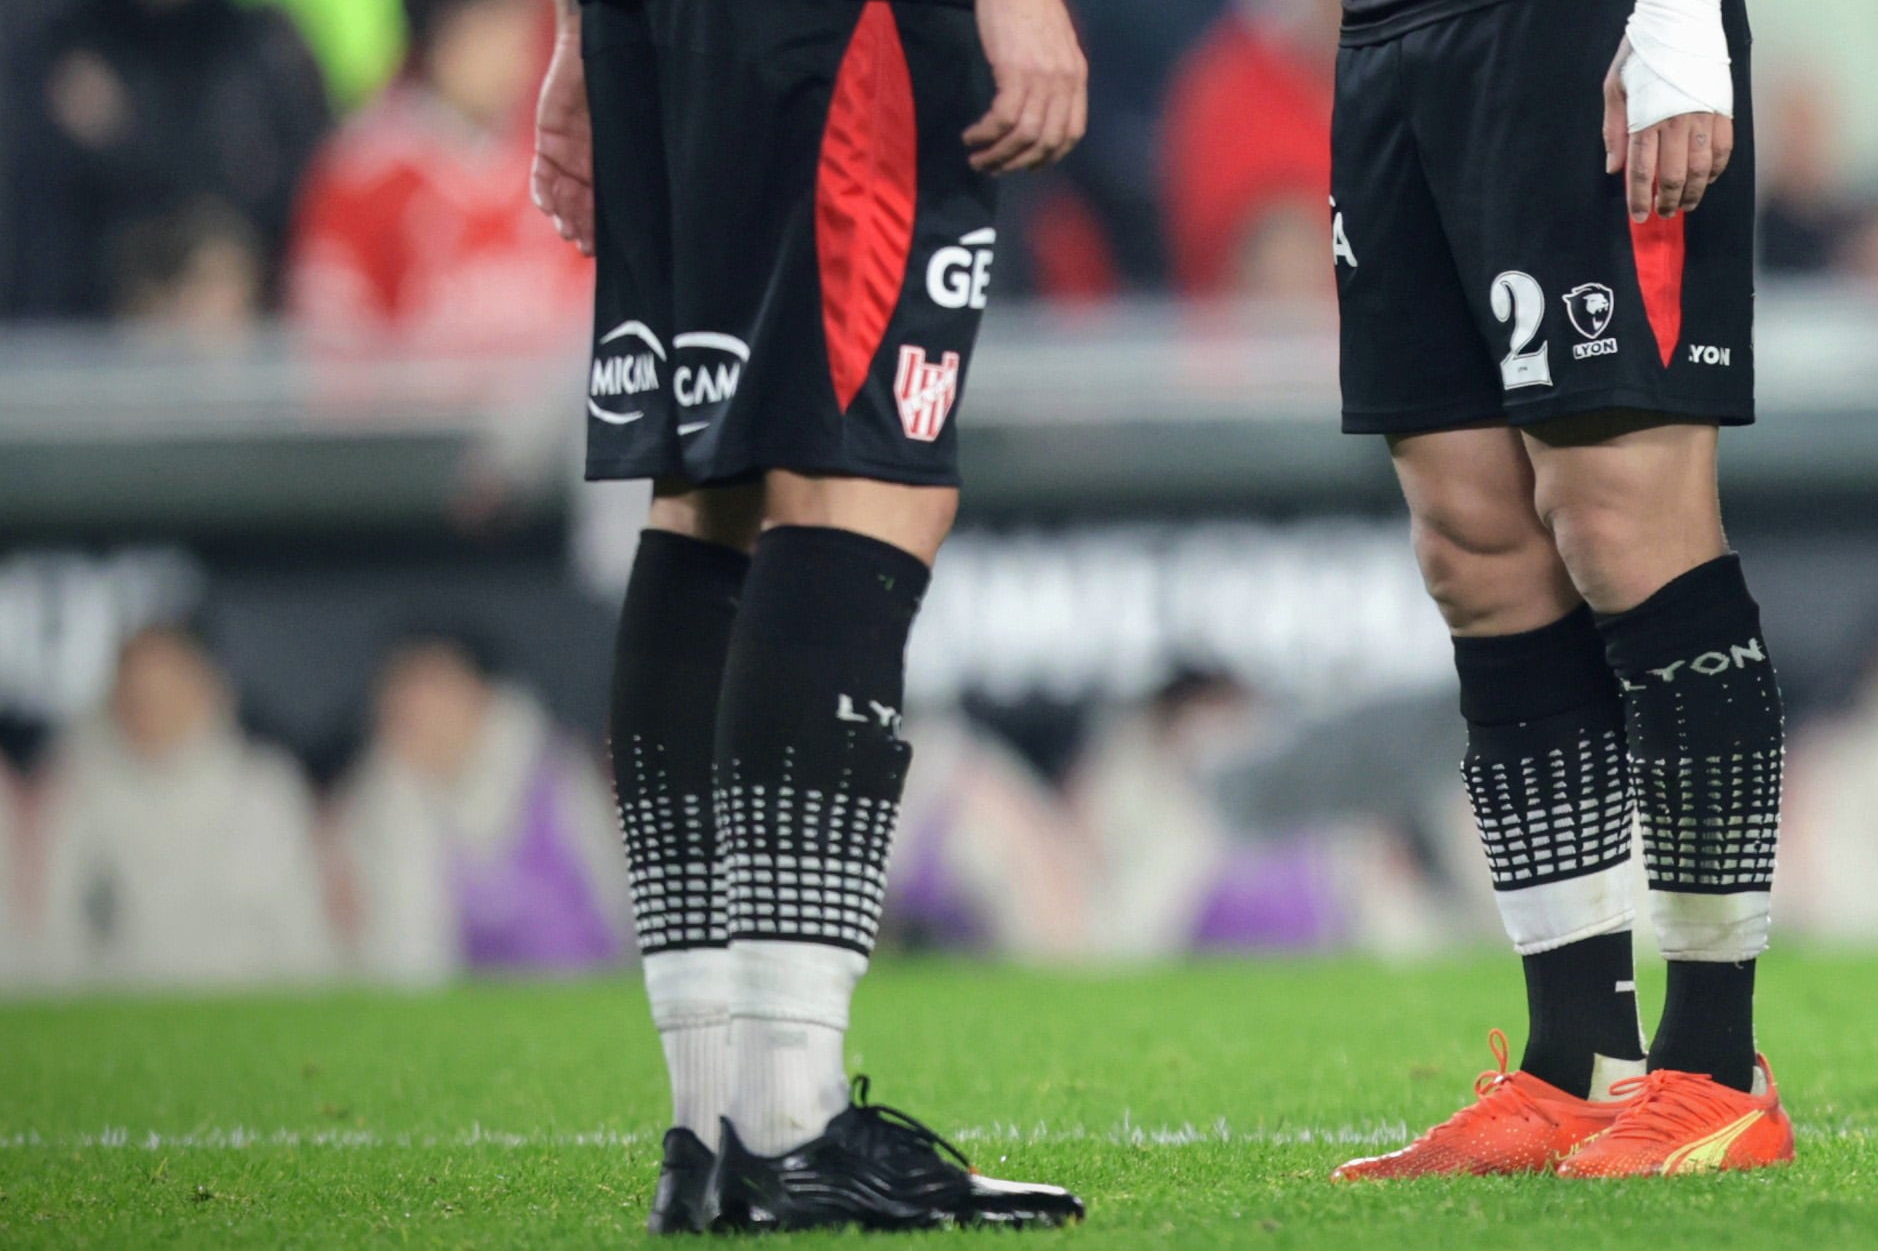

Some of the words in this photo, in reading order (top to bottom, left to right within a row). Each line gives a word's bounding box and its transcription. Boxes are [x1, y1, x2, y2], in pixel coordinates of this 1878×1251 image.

[926, 245, 994, 309] GE
[1490, 270, 1554, 391] 2
[1573, 338, 1617, 359] LYON
[1688, 344, 1731, 367] YON
[1614, 637, 1767, 692] LYON
